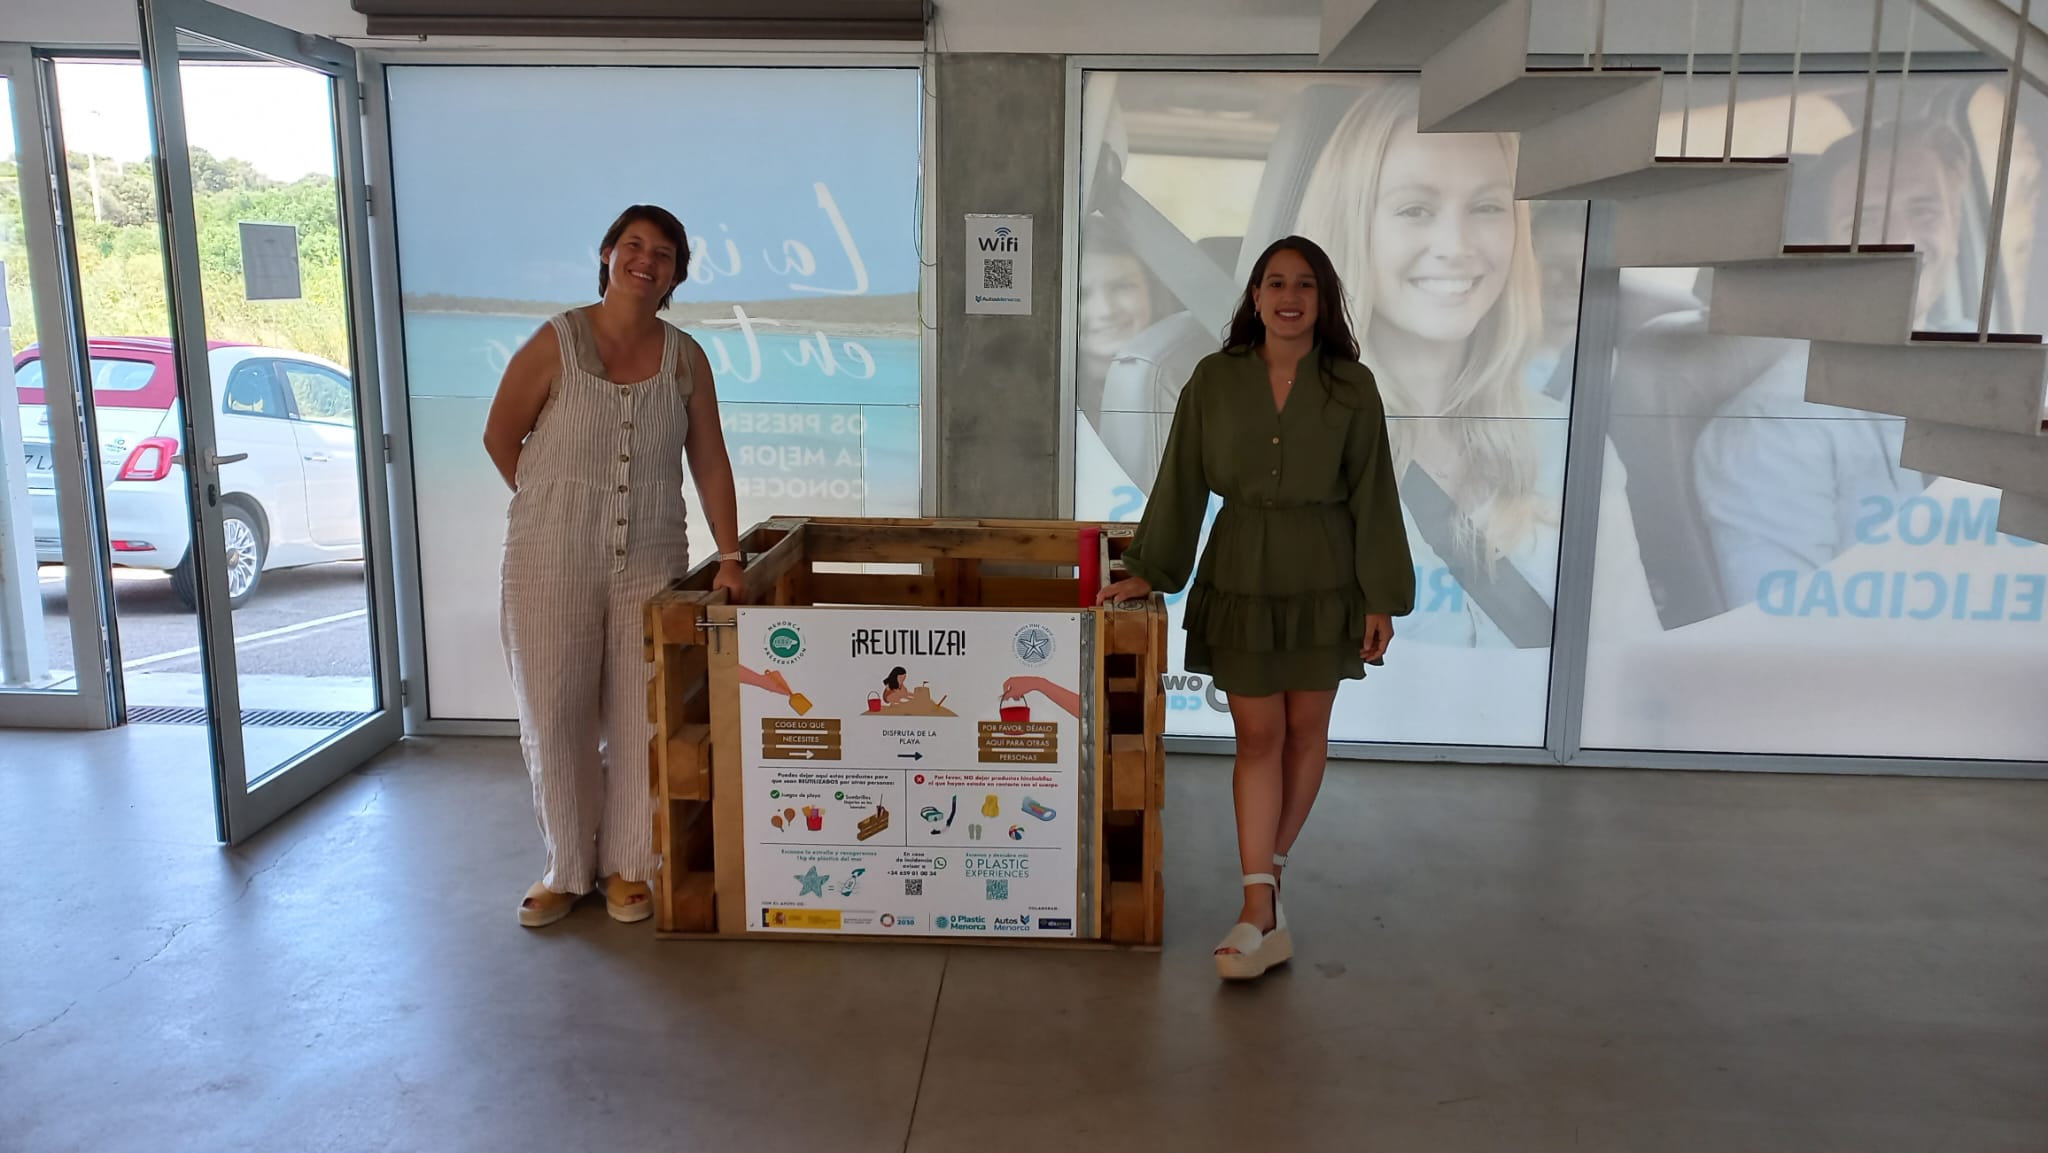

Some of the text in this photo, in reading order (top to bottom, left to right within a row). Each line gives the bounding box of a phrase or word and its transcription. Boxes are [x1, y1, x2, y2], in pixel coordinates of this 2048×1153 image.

[978, 237, 1018, 252] Wifi
[851, 629, 966, 658] ¡REUTILIZA!
[775, 721, 797, 729] COGE
[982, 724, 998, 732] POR
[1006, 739, 1025, 747] PARA
[1000, 753, 1037, 761] PERSONAS
[977, 858, 1029, 869] PLASTIC
[965, 869, 1030, 878] EXPERIENCES
[957, 915, 986, 924] Plastic
[994, 917, 1019, 925] Autos
[950, 923, 986, 931] Menorca
